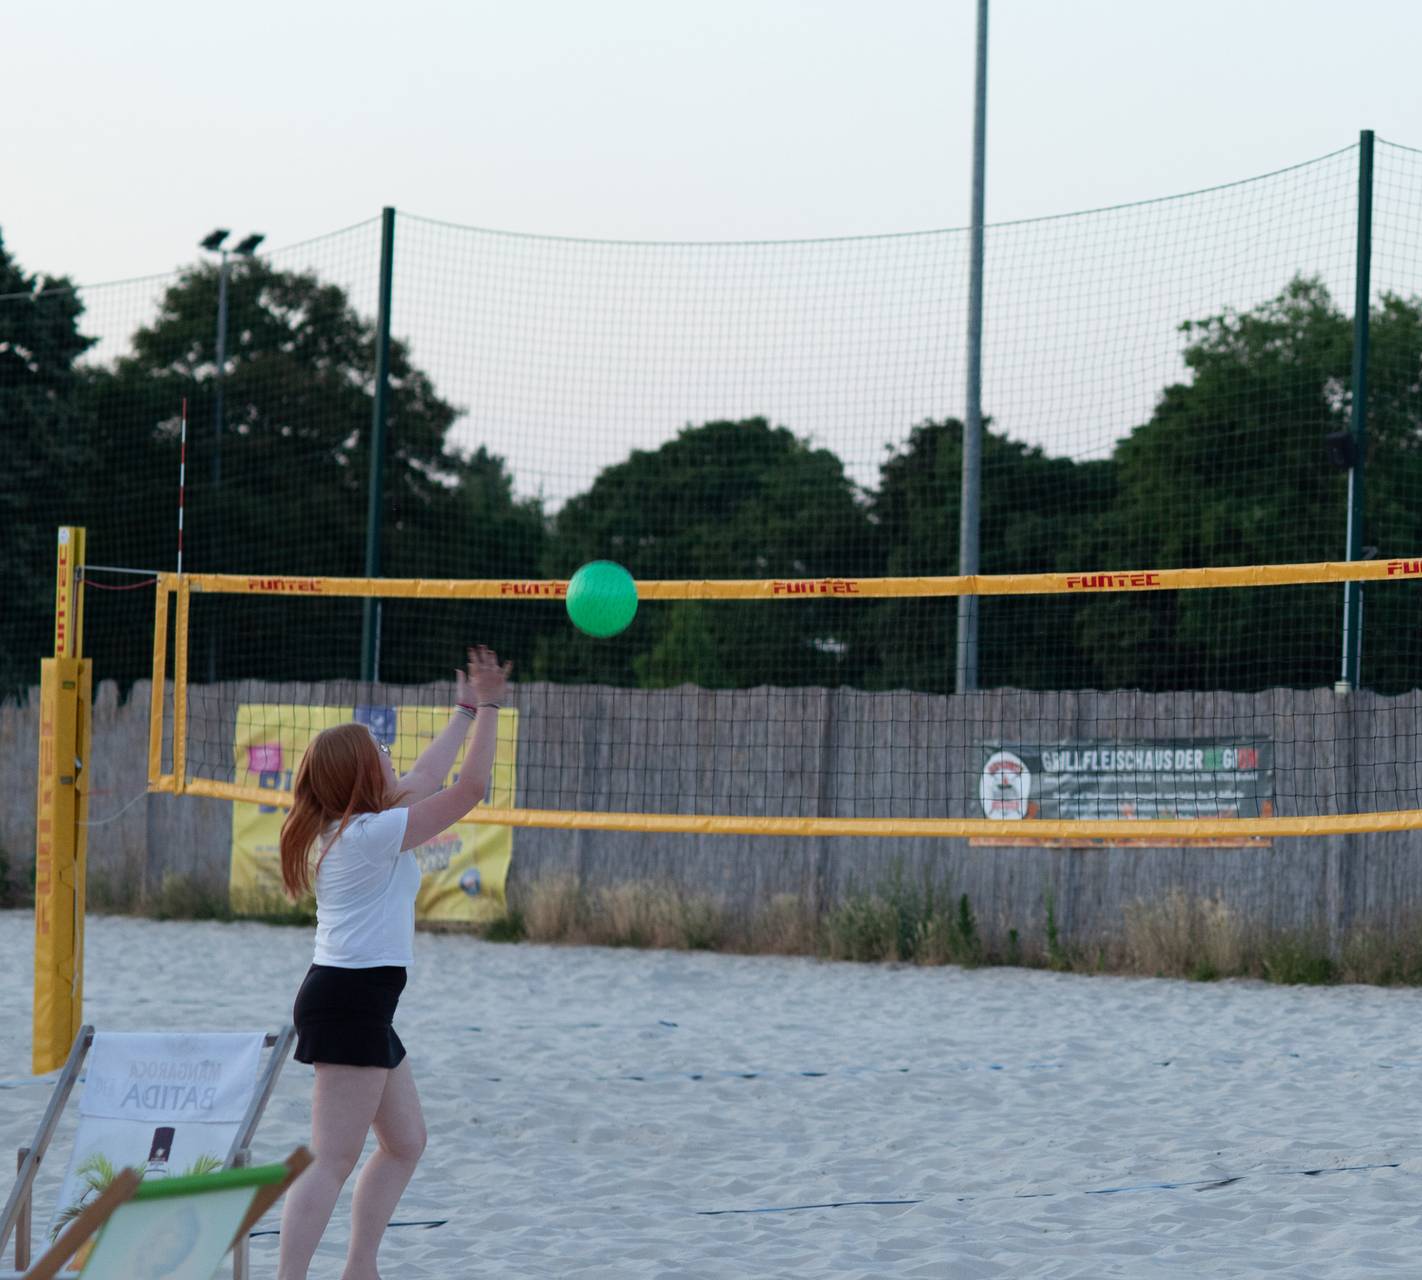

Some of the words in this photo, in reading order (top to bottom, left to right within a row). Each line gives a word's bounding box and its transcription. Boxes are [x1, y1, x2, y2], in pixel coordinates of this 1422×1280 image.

[249, 579, 322, 592] FUNTEC
[773, 580, 860, 595] FUNTEC
[1066, 573, 1161, 589] FUNTEC
[501, 583, 567, 596] FUNTE
[57, 544, 67, 655] UNTEC
